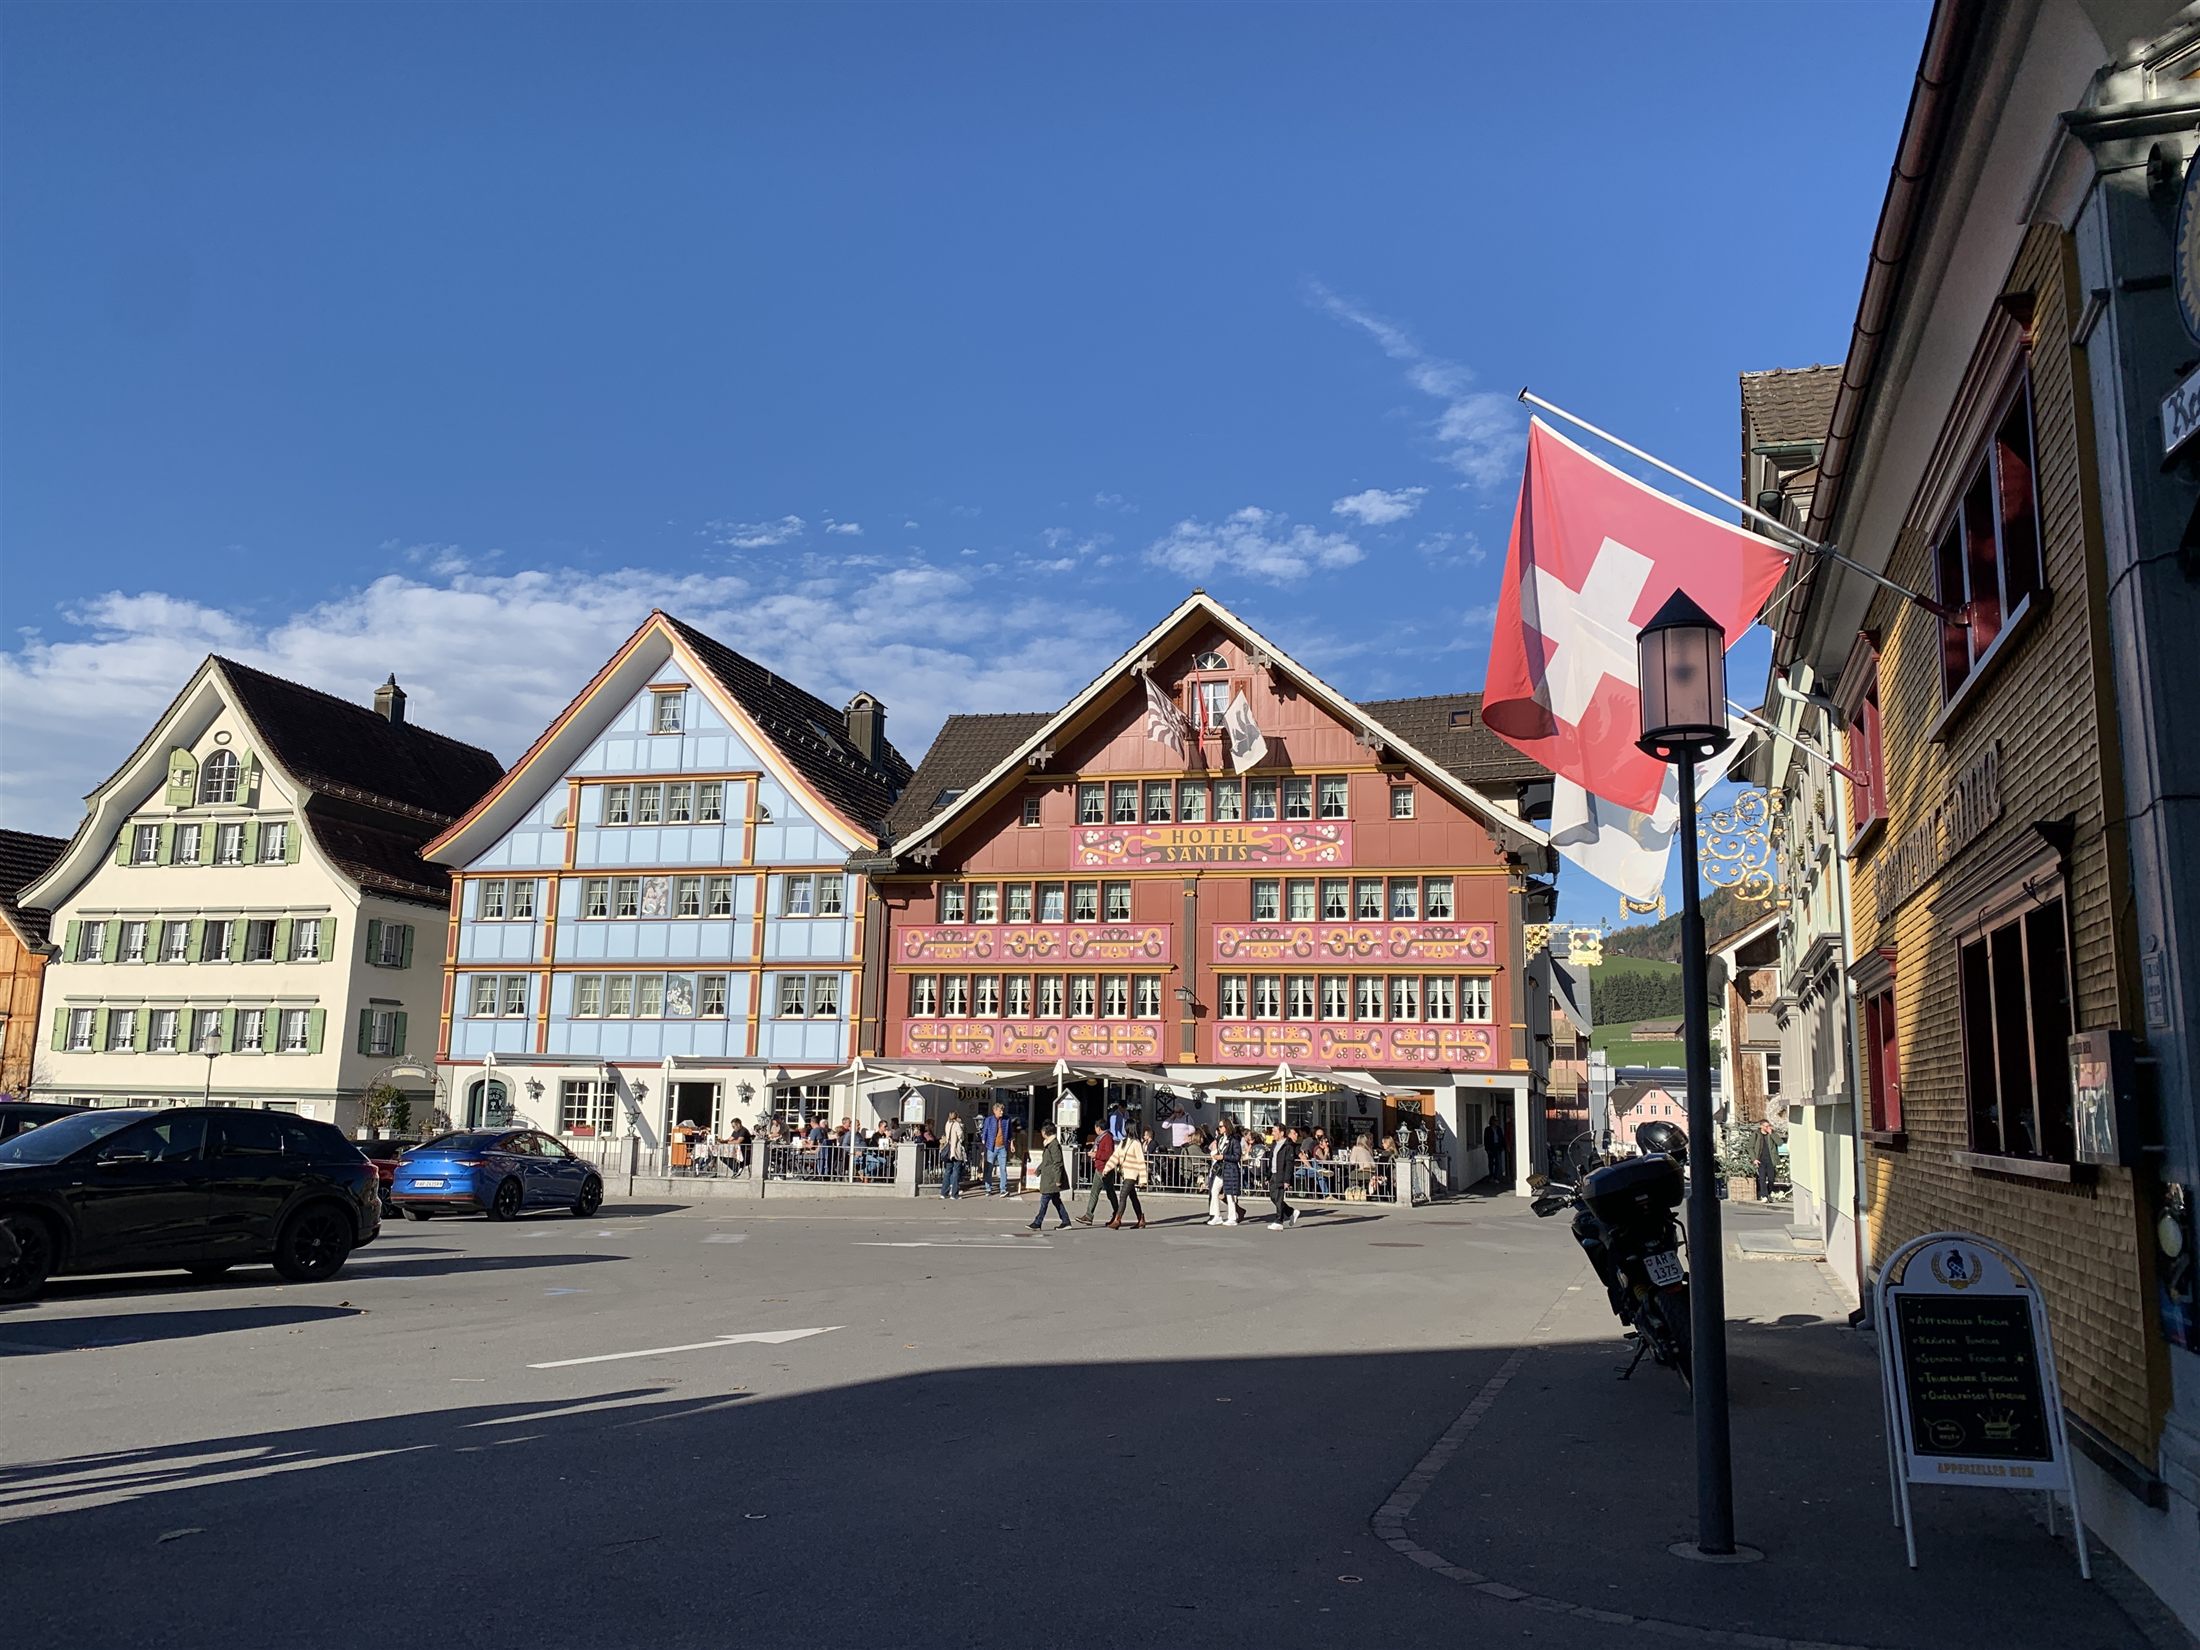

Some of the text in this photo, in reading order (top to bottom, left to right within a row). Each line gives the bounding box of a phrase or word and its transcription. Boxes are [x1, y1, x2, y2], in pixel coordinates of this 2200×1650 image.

[1941, 740, 2001, 863] Sonne
[1172, 829, 1247, 844] HOTEL
[1166, 846, 1248, 862] SÄNTIS
[1655, 1254, 1669, 1266] AR
[1654, 1264, 1679, 1280] 1375
[1937, 1462, 2006, 1476] APPENZELLER
